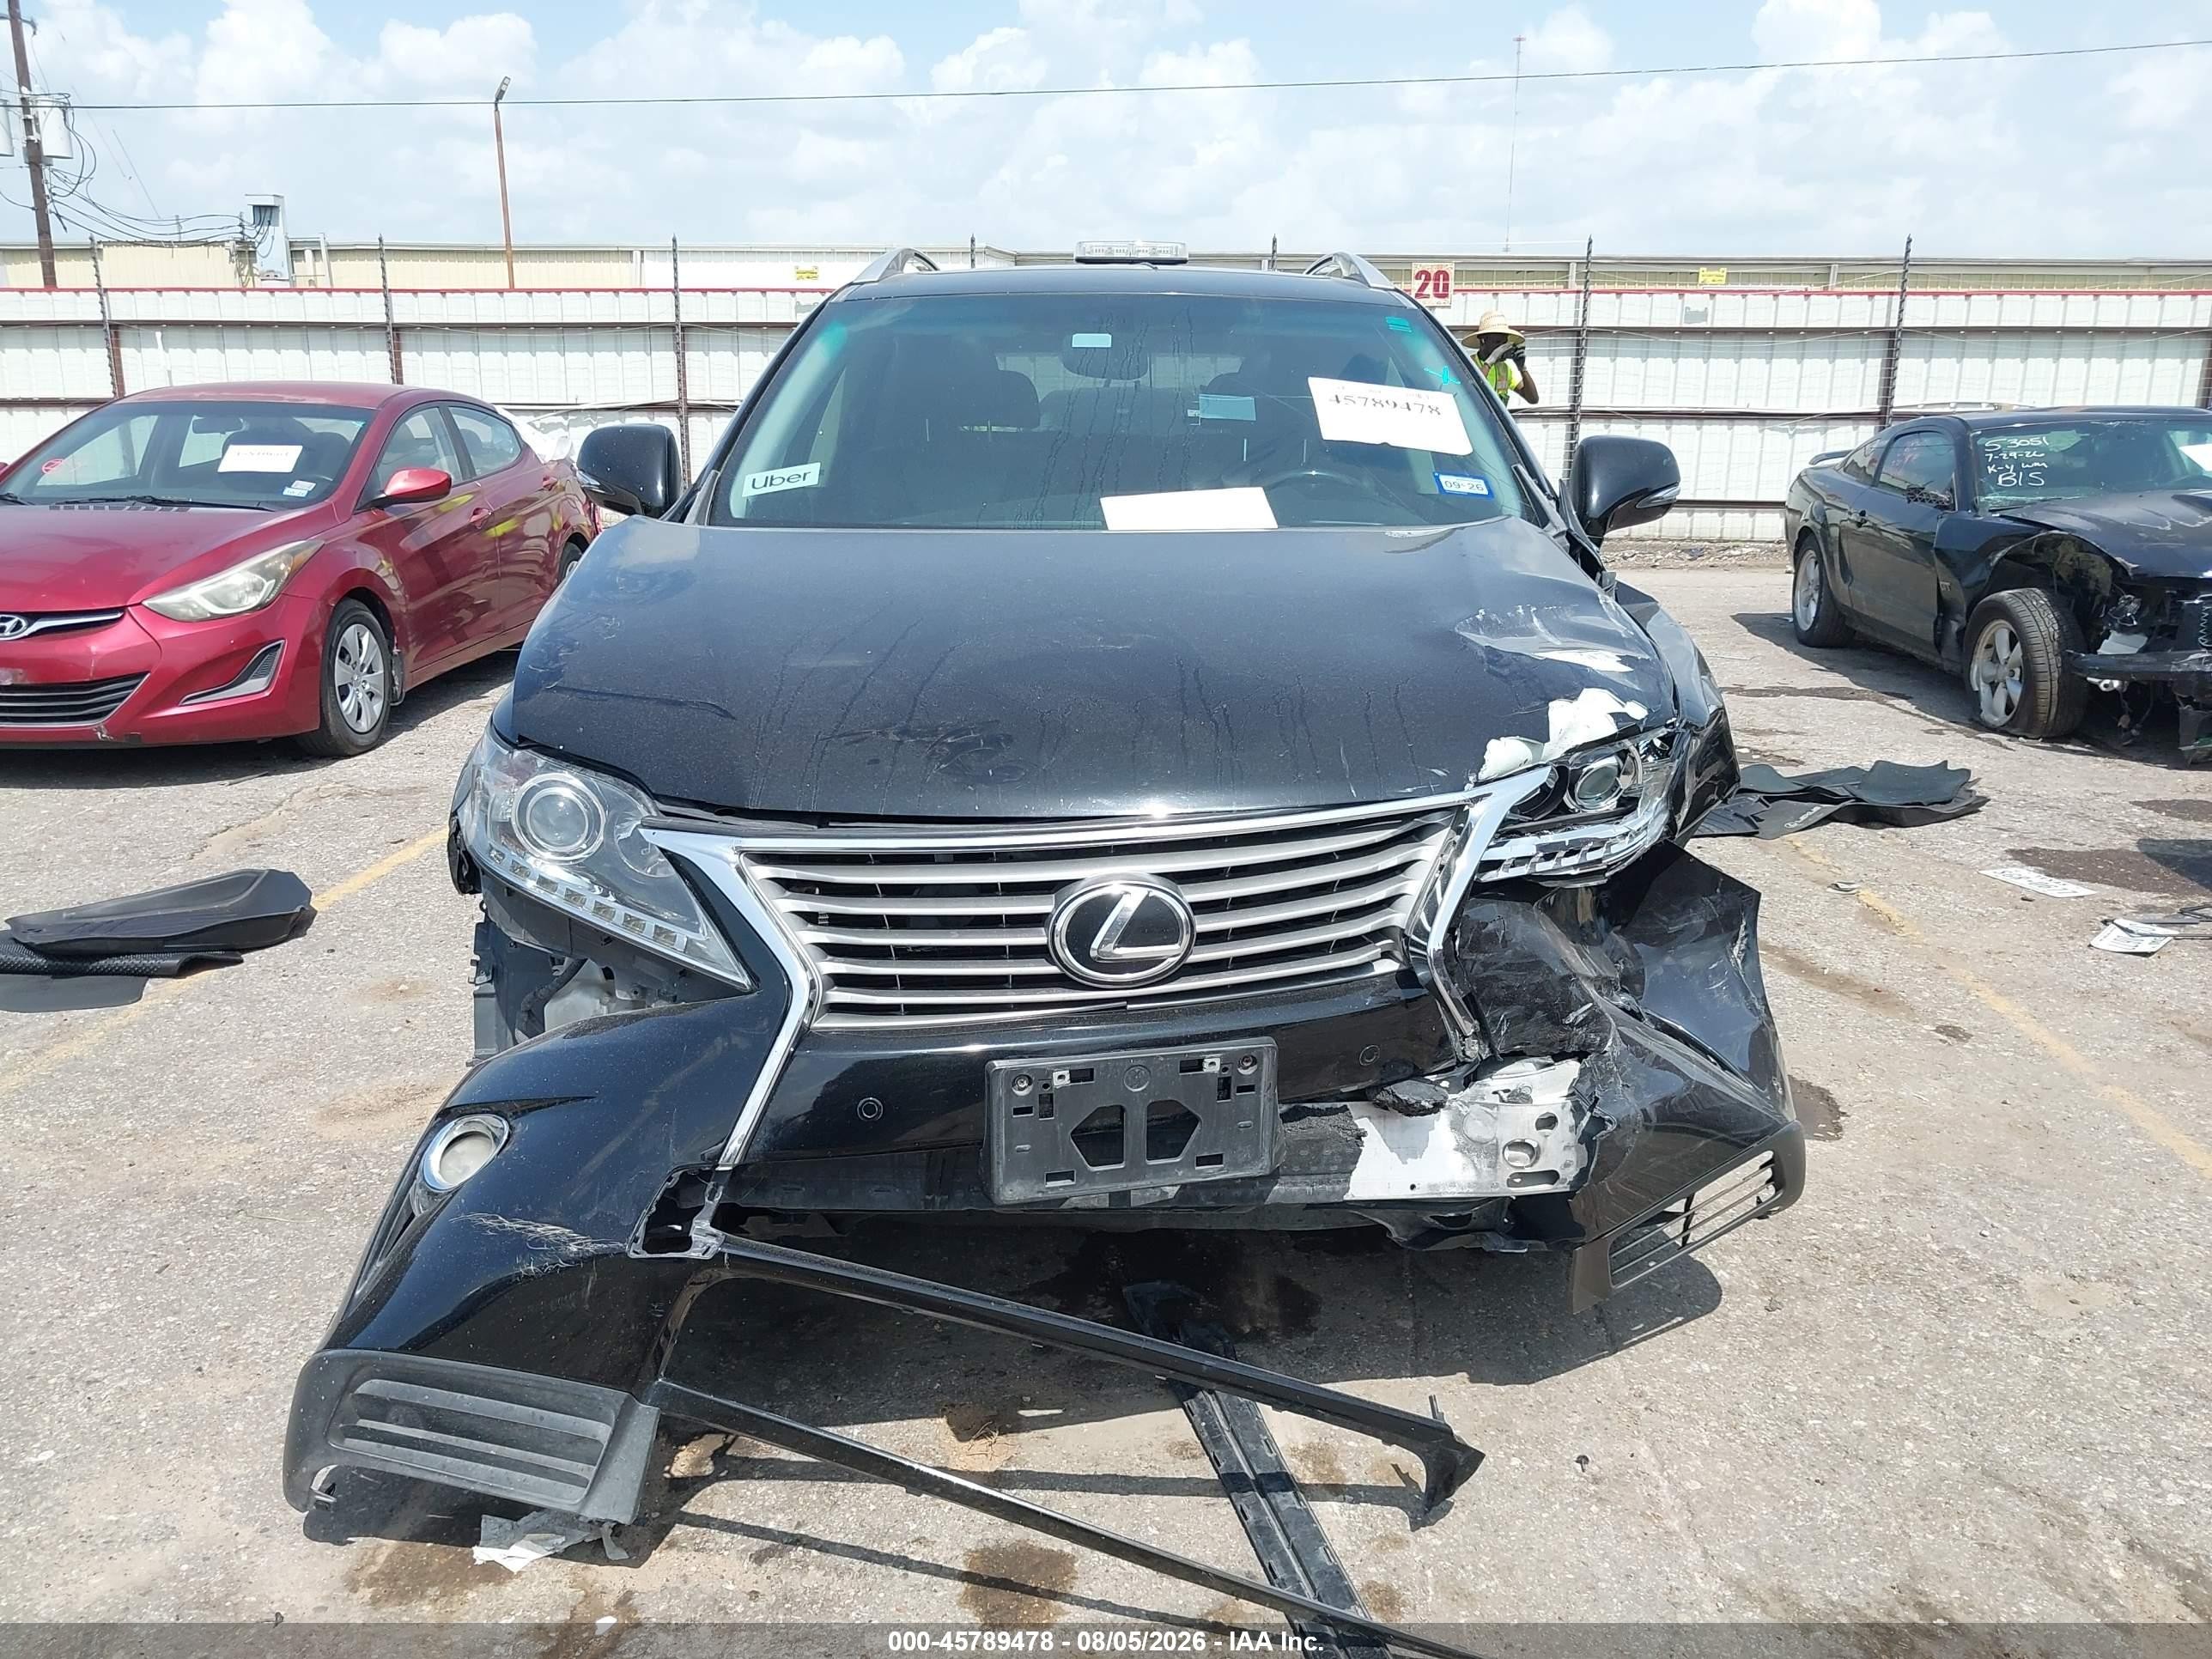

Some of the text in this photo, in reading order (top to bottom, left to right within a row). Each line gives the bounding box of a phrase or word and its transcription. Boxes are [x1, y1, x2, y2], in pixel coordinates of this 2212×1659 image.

[1414, 270, 1449, 299] 20
[1328, 394, 1441, 416] 45789478
[751, 471, 811, 489] Uber
